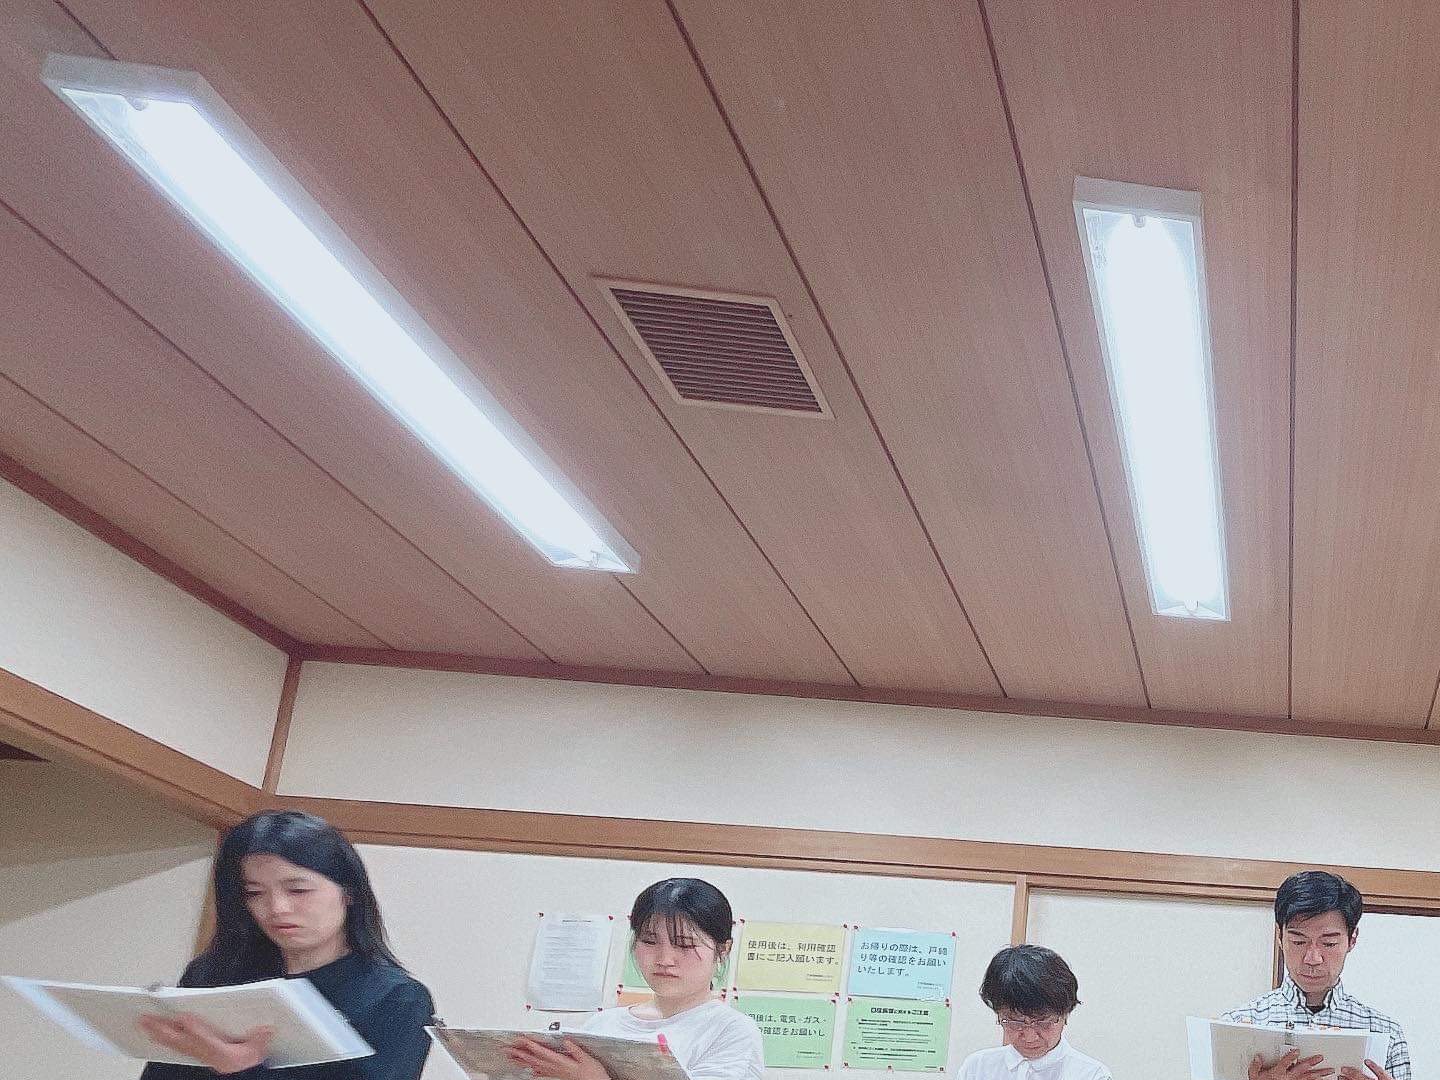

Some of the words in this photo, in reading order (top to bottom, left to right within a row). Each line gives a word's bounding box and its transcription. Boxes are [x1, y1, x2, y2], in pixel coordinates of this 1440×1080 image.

[857, 965, 909, 977] いたします。
